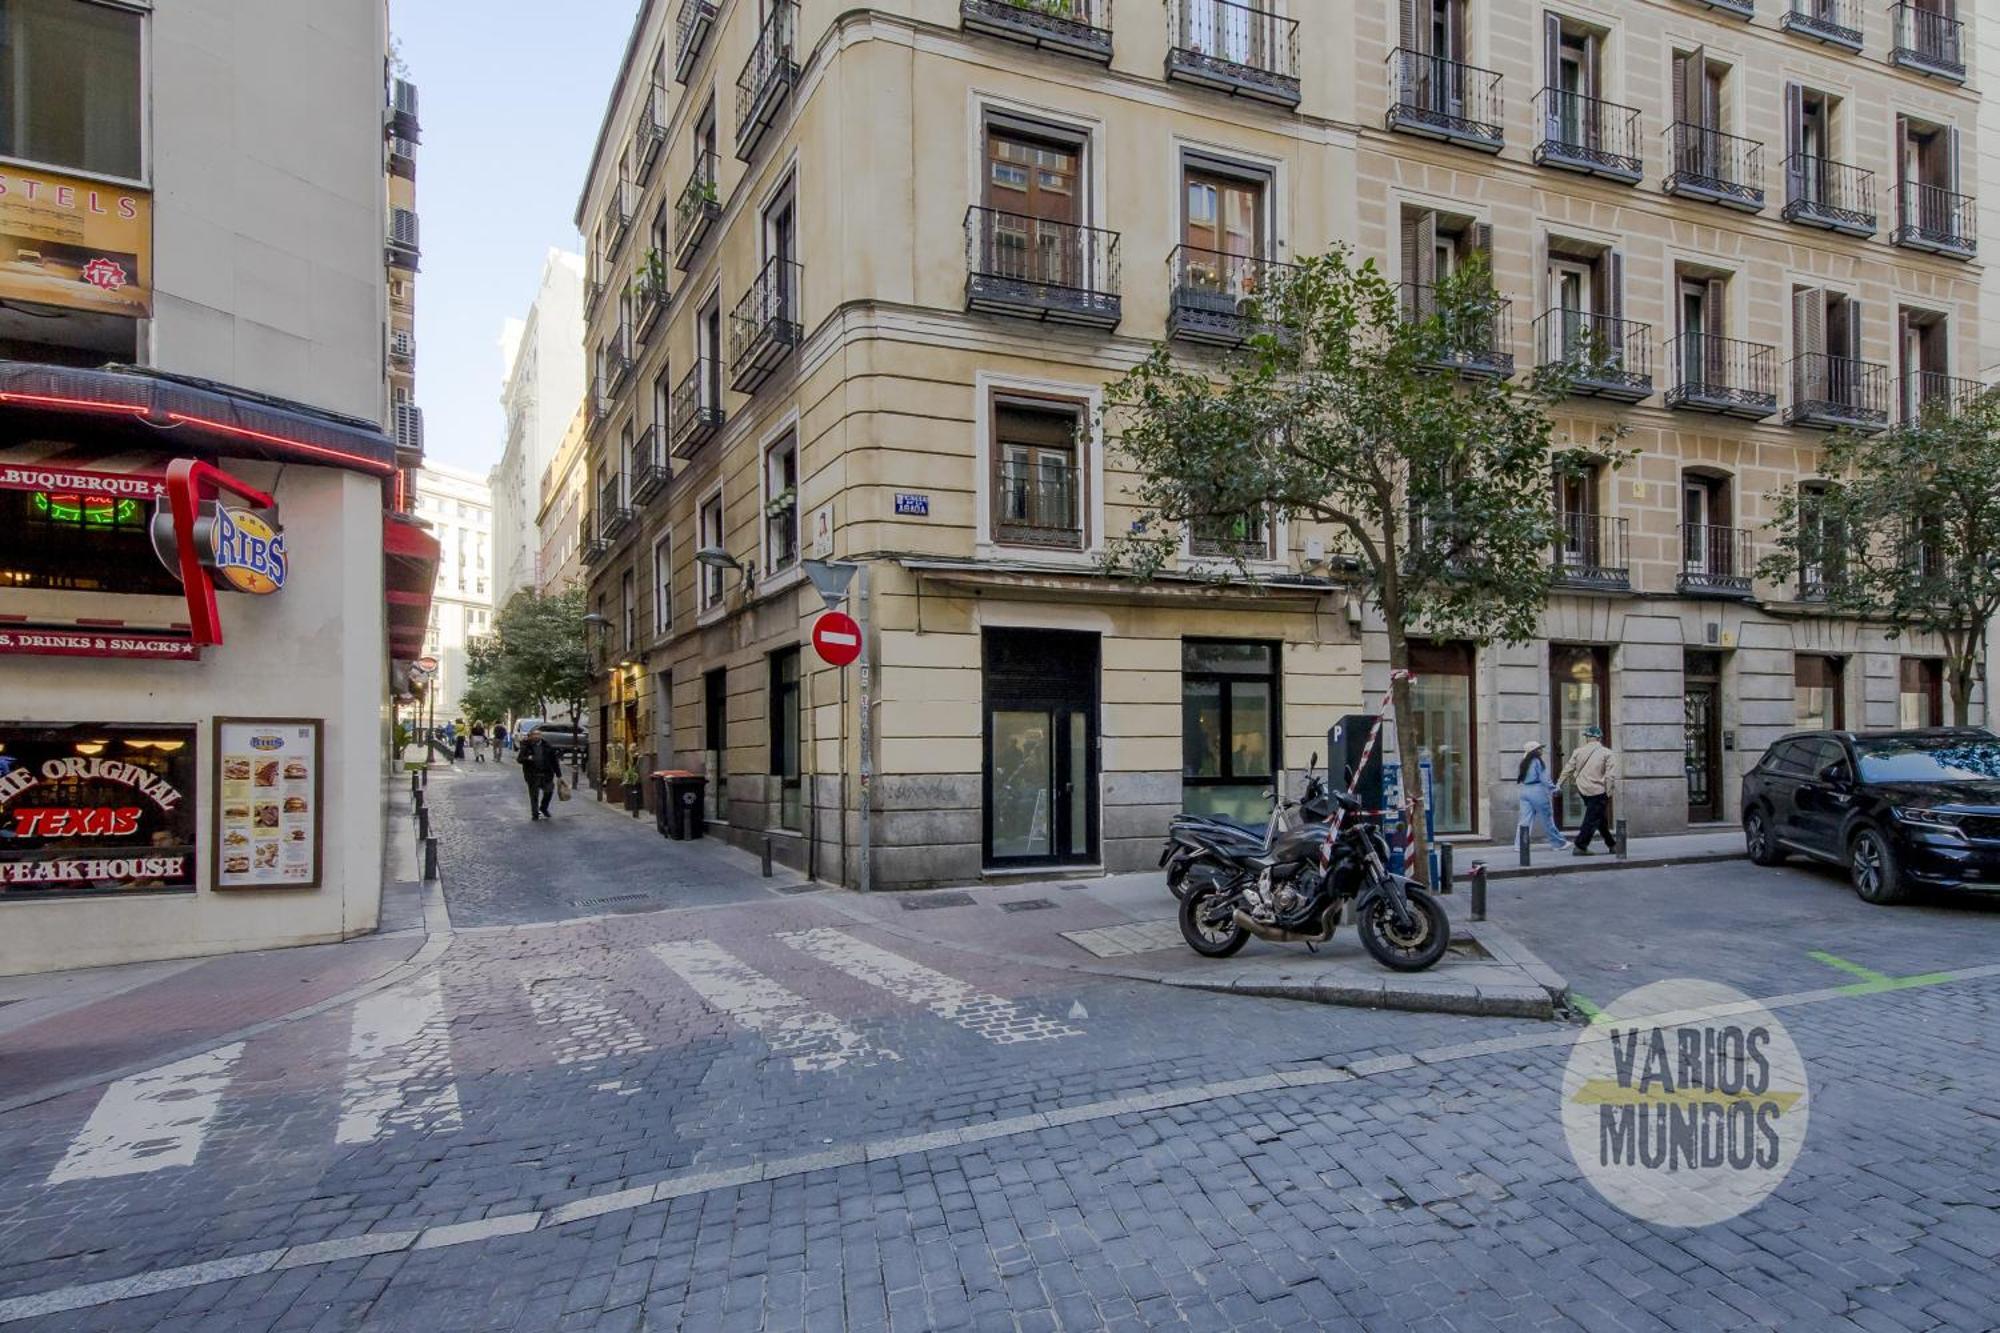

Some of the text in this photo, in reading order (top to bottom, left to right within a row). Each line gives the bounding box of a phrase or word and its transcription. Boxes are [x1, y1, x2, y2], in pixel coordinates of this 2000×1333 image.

[216, 502, 285, 587] RIBS
[18, 635, 92, 649] DRINKS
[95, 638, 106, 650] &
[110, 639, 181, 653] SNACKS
[1333, 725, 1342, 742] P
[42, 757, 182, 811] ORIGINAL
[13, 807, 142, 838] TEXAS
